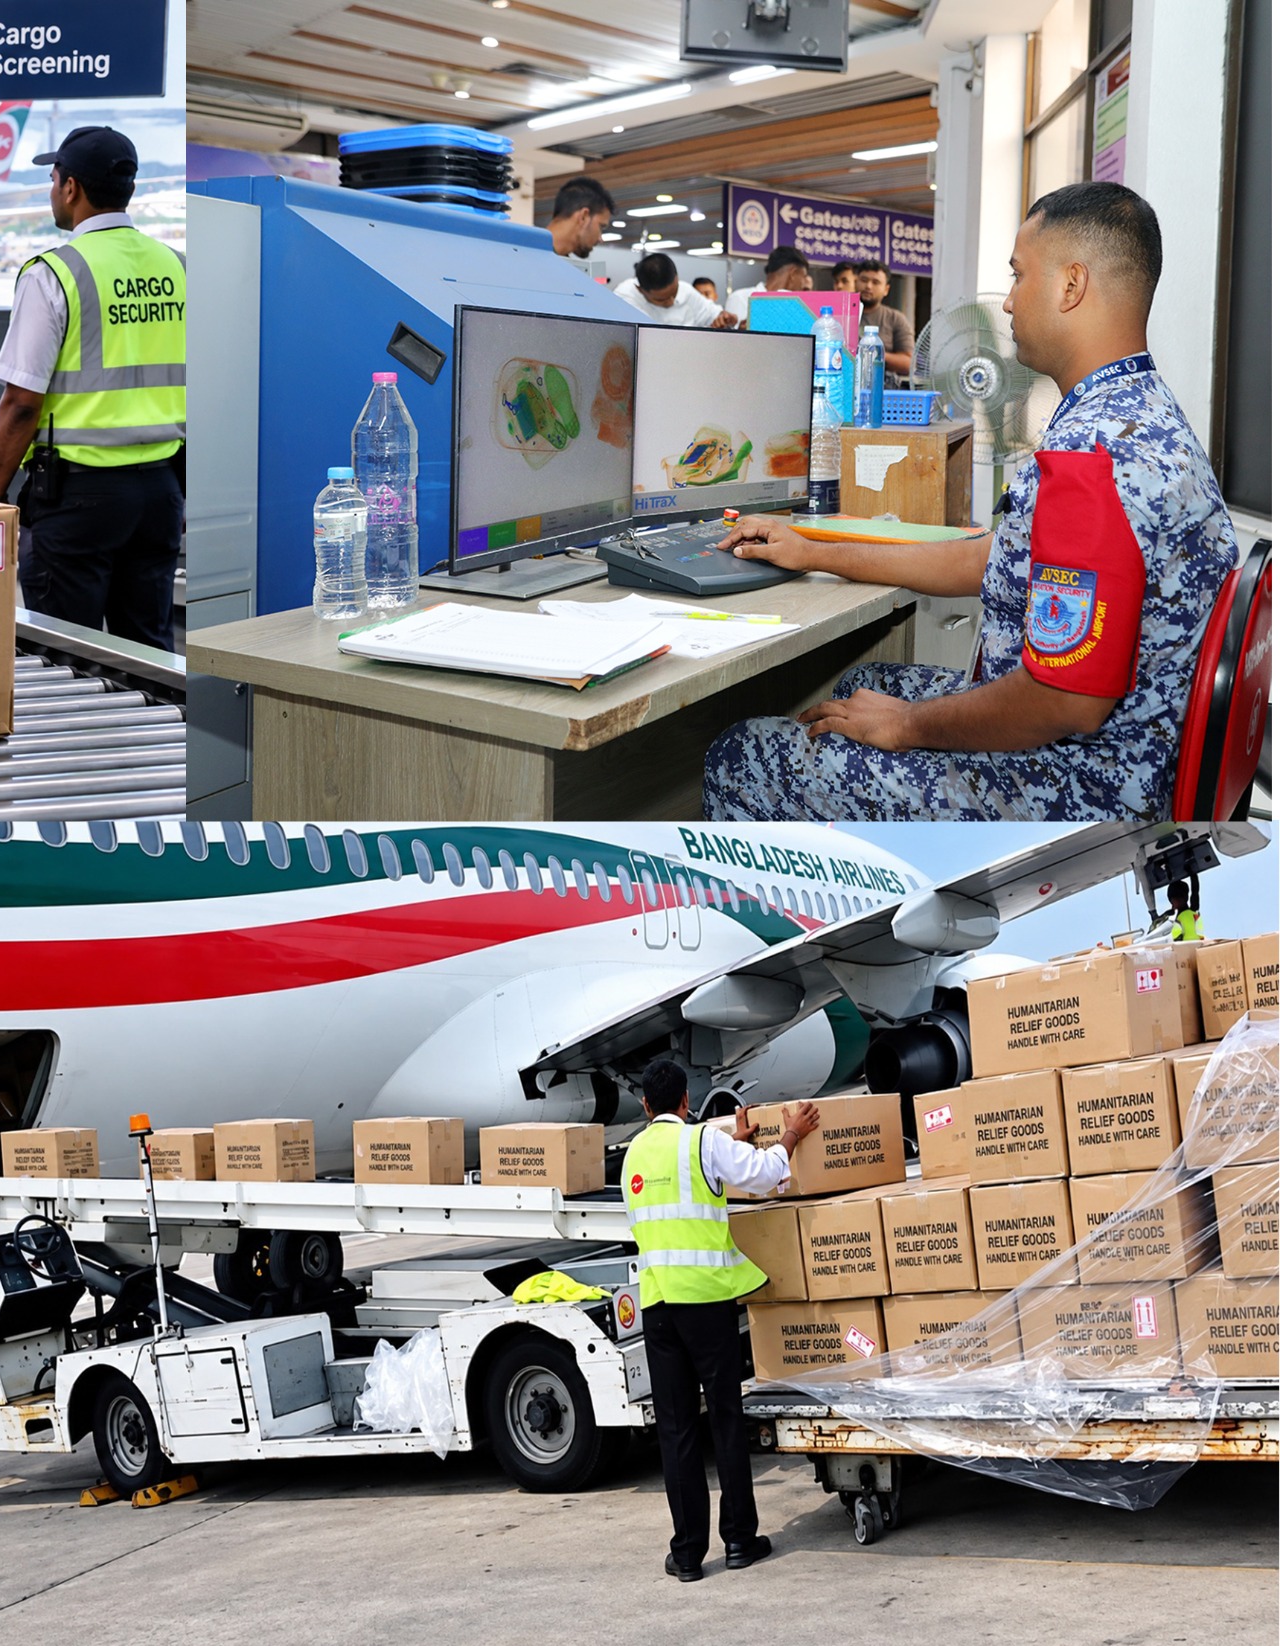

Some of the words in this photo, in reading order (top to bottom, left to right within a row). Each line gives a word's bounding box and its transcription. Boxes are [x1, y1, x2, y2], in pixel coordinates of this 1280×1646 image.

[113, 276, 175, 298] CARGO
[108, 302, 185, 325] SECURITY
[1092, 364, 1122, 382] AVSEC
[1039, 568, 1080, 586] AVSEC
[1056, 586, 1091, 598] SECURITY
[1092, 600, 1107, 639] AIRPORT
[678, 827, 828, 881] BANGLADESH
[829, 857, 906, 895] AIRLINES
[1008, 996, 1080, 1019] HUMANITARIAN
[1010, 1018, 1043, 1034] RELIEF
[1045, 1013, 1080, 1028] GOODS
[1008, 1036, 1039, 1050] HANDLE
[1040, 1032, 1060, 1044] WITH
[1062, 1028, 1085, 1041] CARE
[1077, 1092, 1154, 1113] HUMANITARIAN
[975, 1106, 1043, 1125] HUMANITARIAN
[1080, 1114, 1114, 1130] RELIEF
[1118, 1110, 1155, 1126] GOODS
[823, 1125, 880, 1140] HUMANITARIAN
[978, 1126, 1008, 1141] RELIEF
[1011, 1122, 1044, 1138] GOODS
[1079, 1133, 1111, 1146] HANDLE
[1113, 1130, 1134, 1142] WITH
[1136, 1127, 1160, 1139] CARE
[498, 1147, 544, 1155] HUMANITARIAN
[826, 1143, 851, 1155] RELIEF
[854, 1139, 880, 1152] GOODS
[976, 1144, 1004, 1157] HANDLE
[1007, 1142, 1025, 1153] WITH
[1027, 1139, 1049, 1150] CARE
[824, 1159, 849, 1170] HANDLE
[851, 1156, 867, 1167] WITH
[868, 1153, 884, 1164] CARE
[894, 1222, 957, 1238] HUMANITARIAN
[985, 1216, 1055, 1232] HUMANITARIAN
[1245, 1221, 1278, 1234] RELIE
[811, 1232, 870, 1247] HUMANITARIAN
[988, 1235, 1019, 1248] RELIEF
[1022, 1232, 1056, 1246] GOODS
[1128, 1226, 1164, 1240] GOODS
[897, 1241, 925, 1253] RELIEF
[928, 1238, 958, 1249] GOODS
[1123, 1246, 1144, 1257] WITH
[1146, 1243, 1170, 1255] CARE
[1242, 1239, 1279, 1252] HANDLE
[814, 1250, 840, 1262] RELIEF
[842, 1247, 871, 1259] GOODS
[895, 1257, 922, 1267] HANDLE
[923, 1256, 941, 1266] WITH
[943, 1254, 962, 1264] CARE
[986, 1253, 1015, 1264] HANDLE
[1017, 1251, 1037, 1262] WITH
[812, 1265, 838, 1276] HANDLE
[840, 1264, 856, 1274] WITH
[857, 1261, 876, 1272] CARE
[1056, 1310, 1132, 1325] HUMANITARIAN
[782, 1323, 840, 1335] HUMANITARIAN
[1096, 1328, 1132, 1340] GOODS
[1210, 1325, 1247, 1338] RELIEF
[1252, 1323, 1279, 1336] GOO
[785, 1339, 810, 1350] RELIEF
[813, 1338, 841, 1349] GOODS
[1091, 1346, 1112, 1355] WITH
[1114, 1345, 1138, 1355] CARE
[1208, 1343, 1245, 1354] HANDLE
[1247, 1342, 1270, 1353] WITH
[783, 1355, 808, 1364] HANDLE
[810, 1354, 826, 1363] WITH
[828, 1353, 846, 1363] CARE
